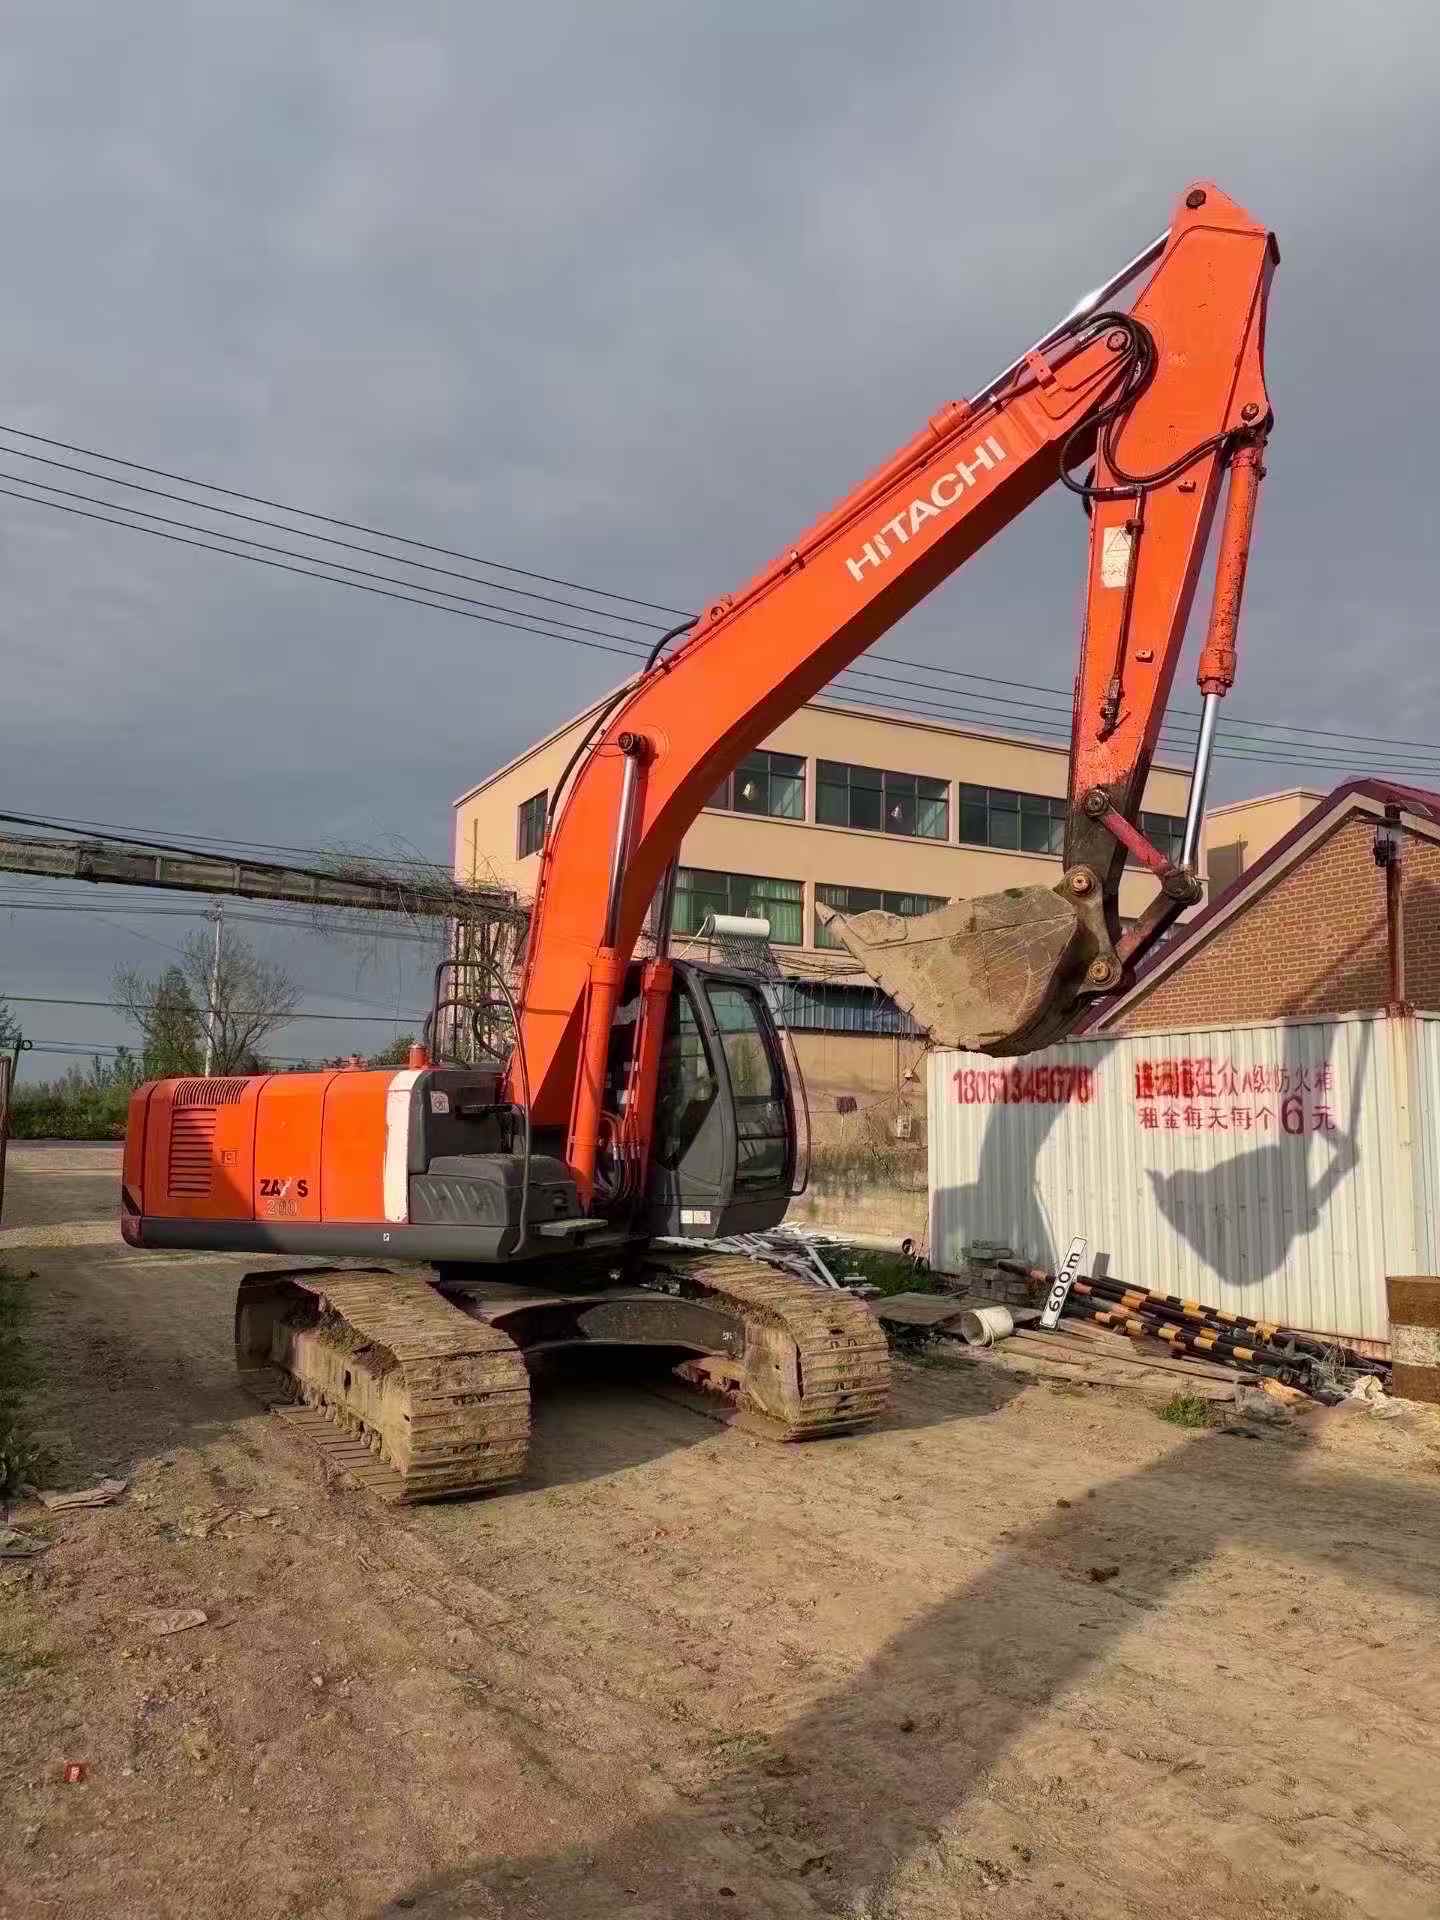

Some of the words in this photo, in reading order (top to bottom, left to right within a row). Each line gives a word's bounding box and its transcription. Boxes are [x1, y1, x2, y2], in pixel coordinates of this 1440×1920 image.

[845, 435, 1008, 582] HITACHI
[260, 1179, 308, 1197] ZAS
[1049, 1253, 1080, 1311] 600m
